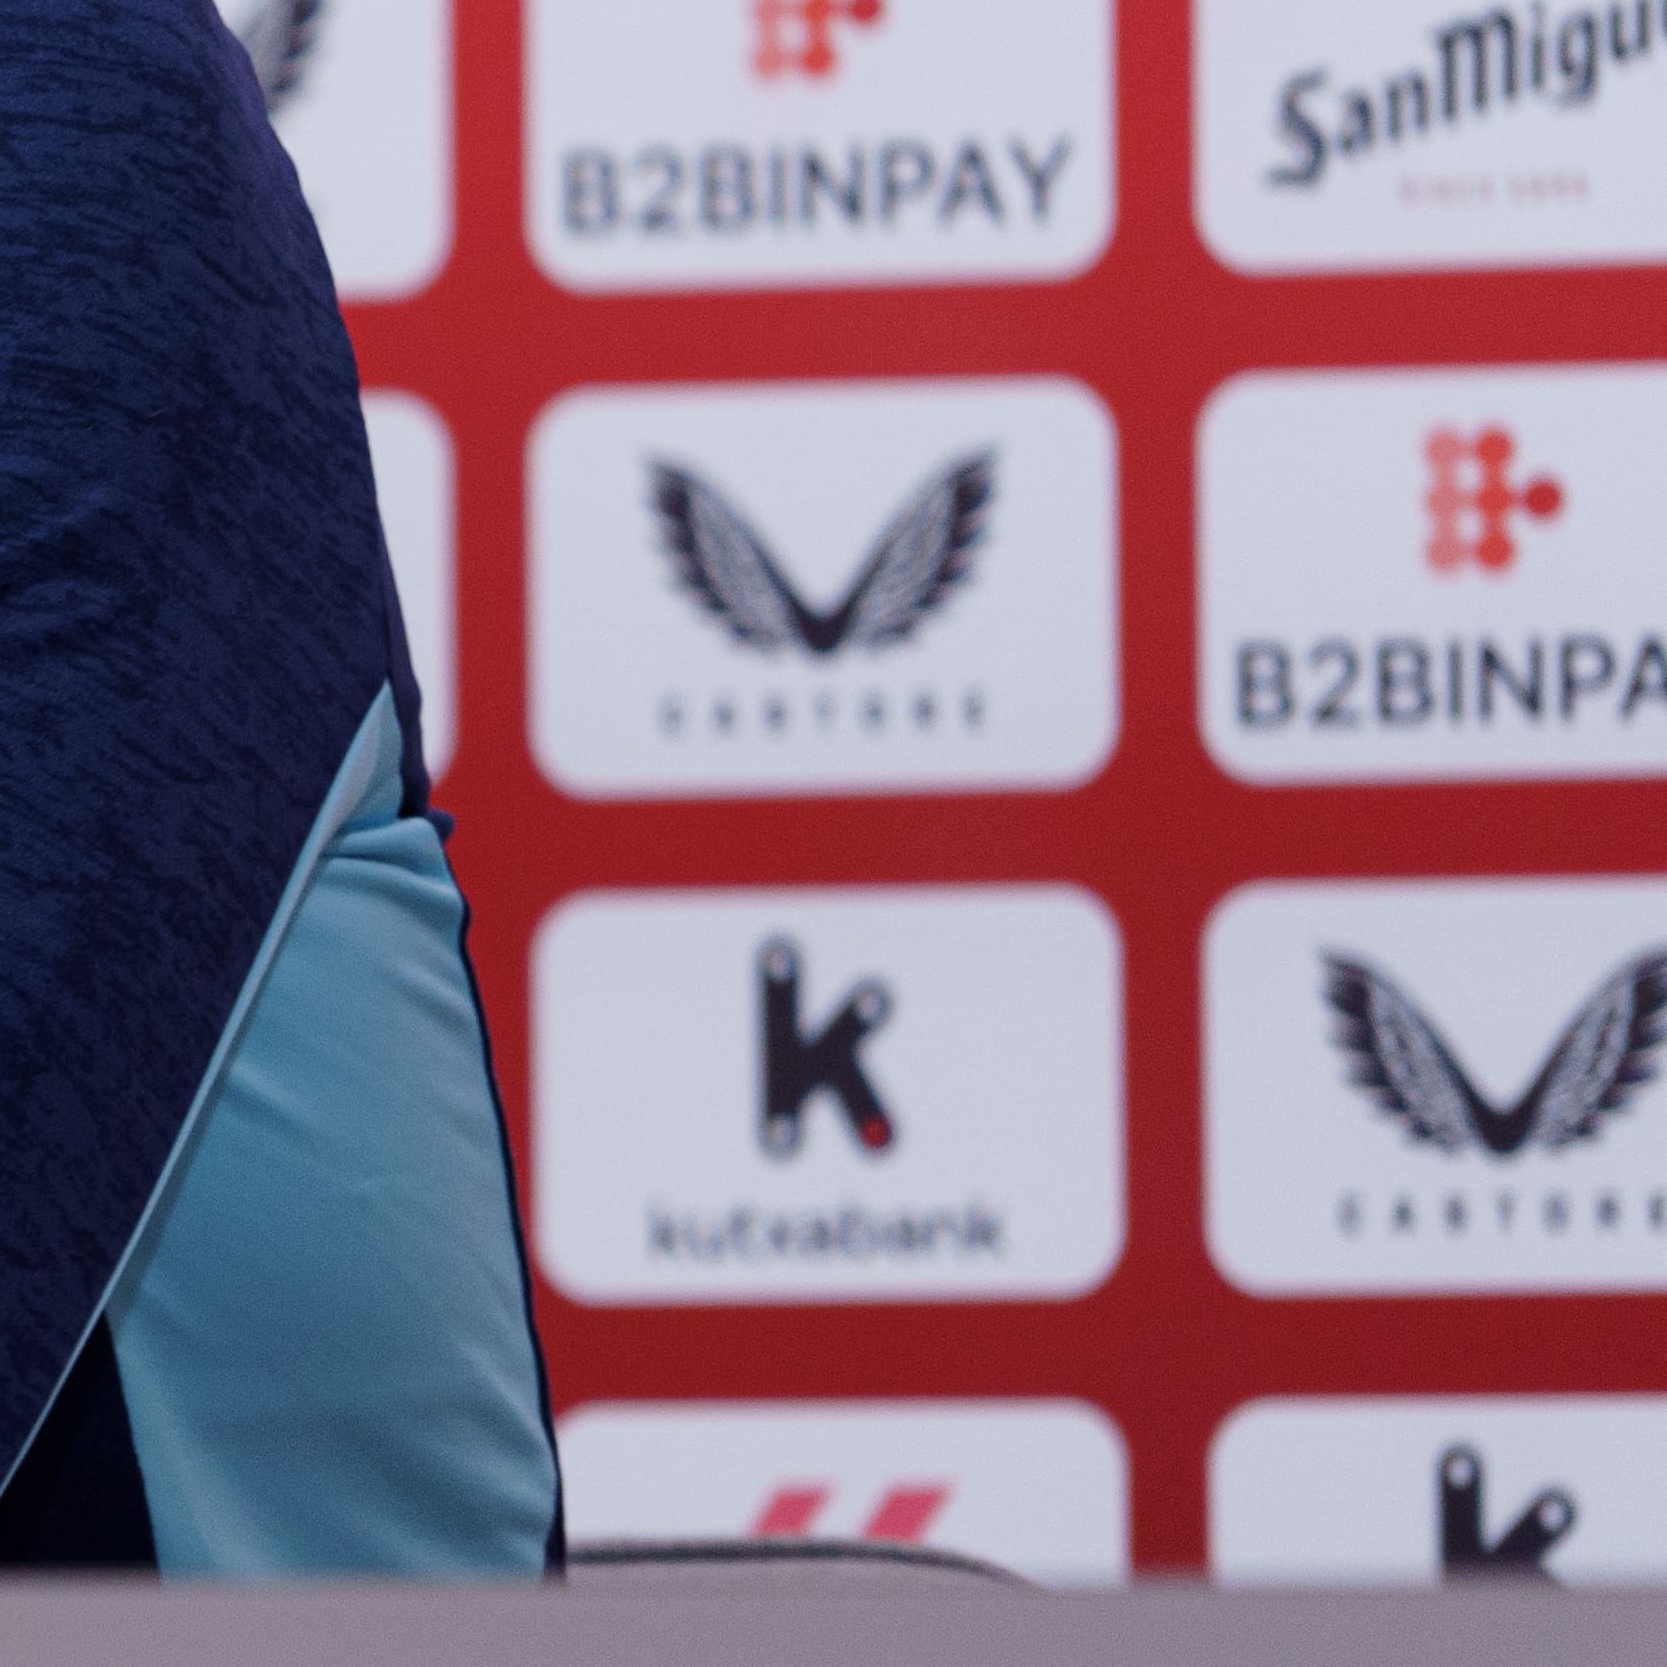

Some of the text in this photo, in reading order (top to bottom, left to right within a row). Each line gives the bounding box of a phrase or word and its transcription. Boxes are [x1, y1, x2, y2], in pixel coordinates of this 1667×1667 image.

[559, 135, 1070, 238] B2BINPAY
[1235, 634, 1667, 729] B2BINPA
[647, 1197, 1006, 1263] kutxabank
